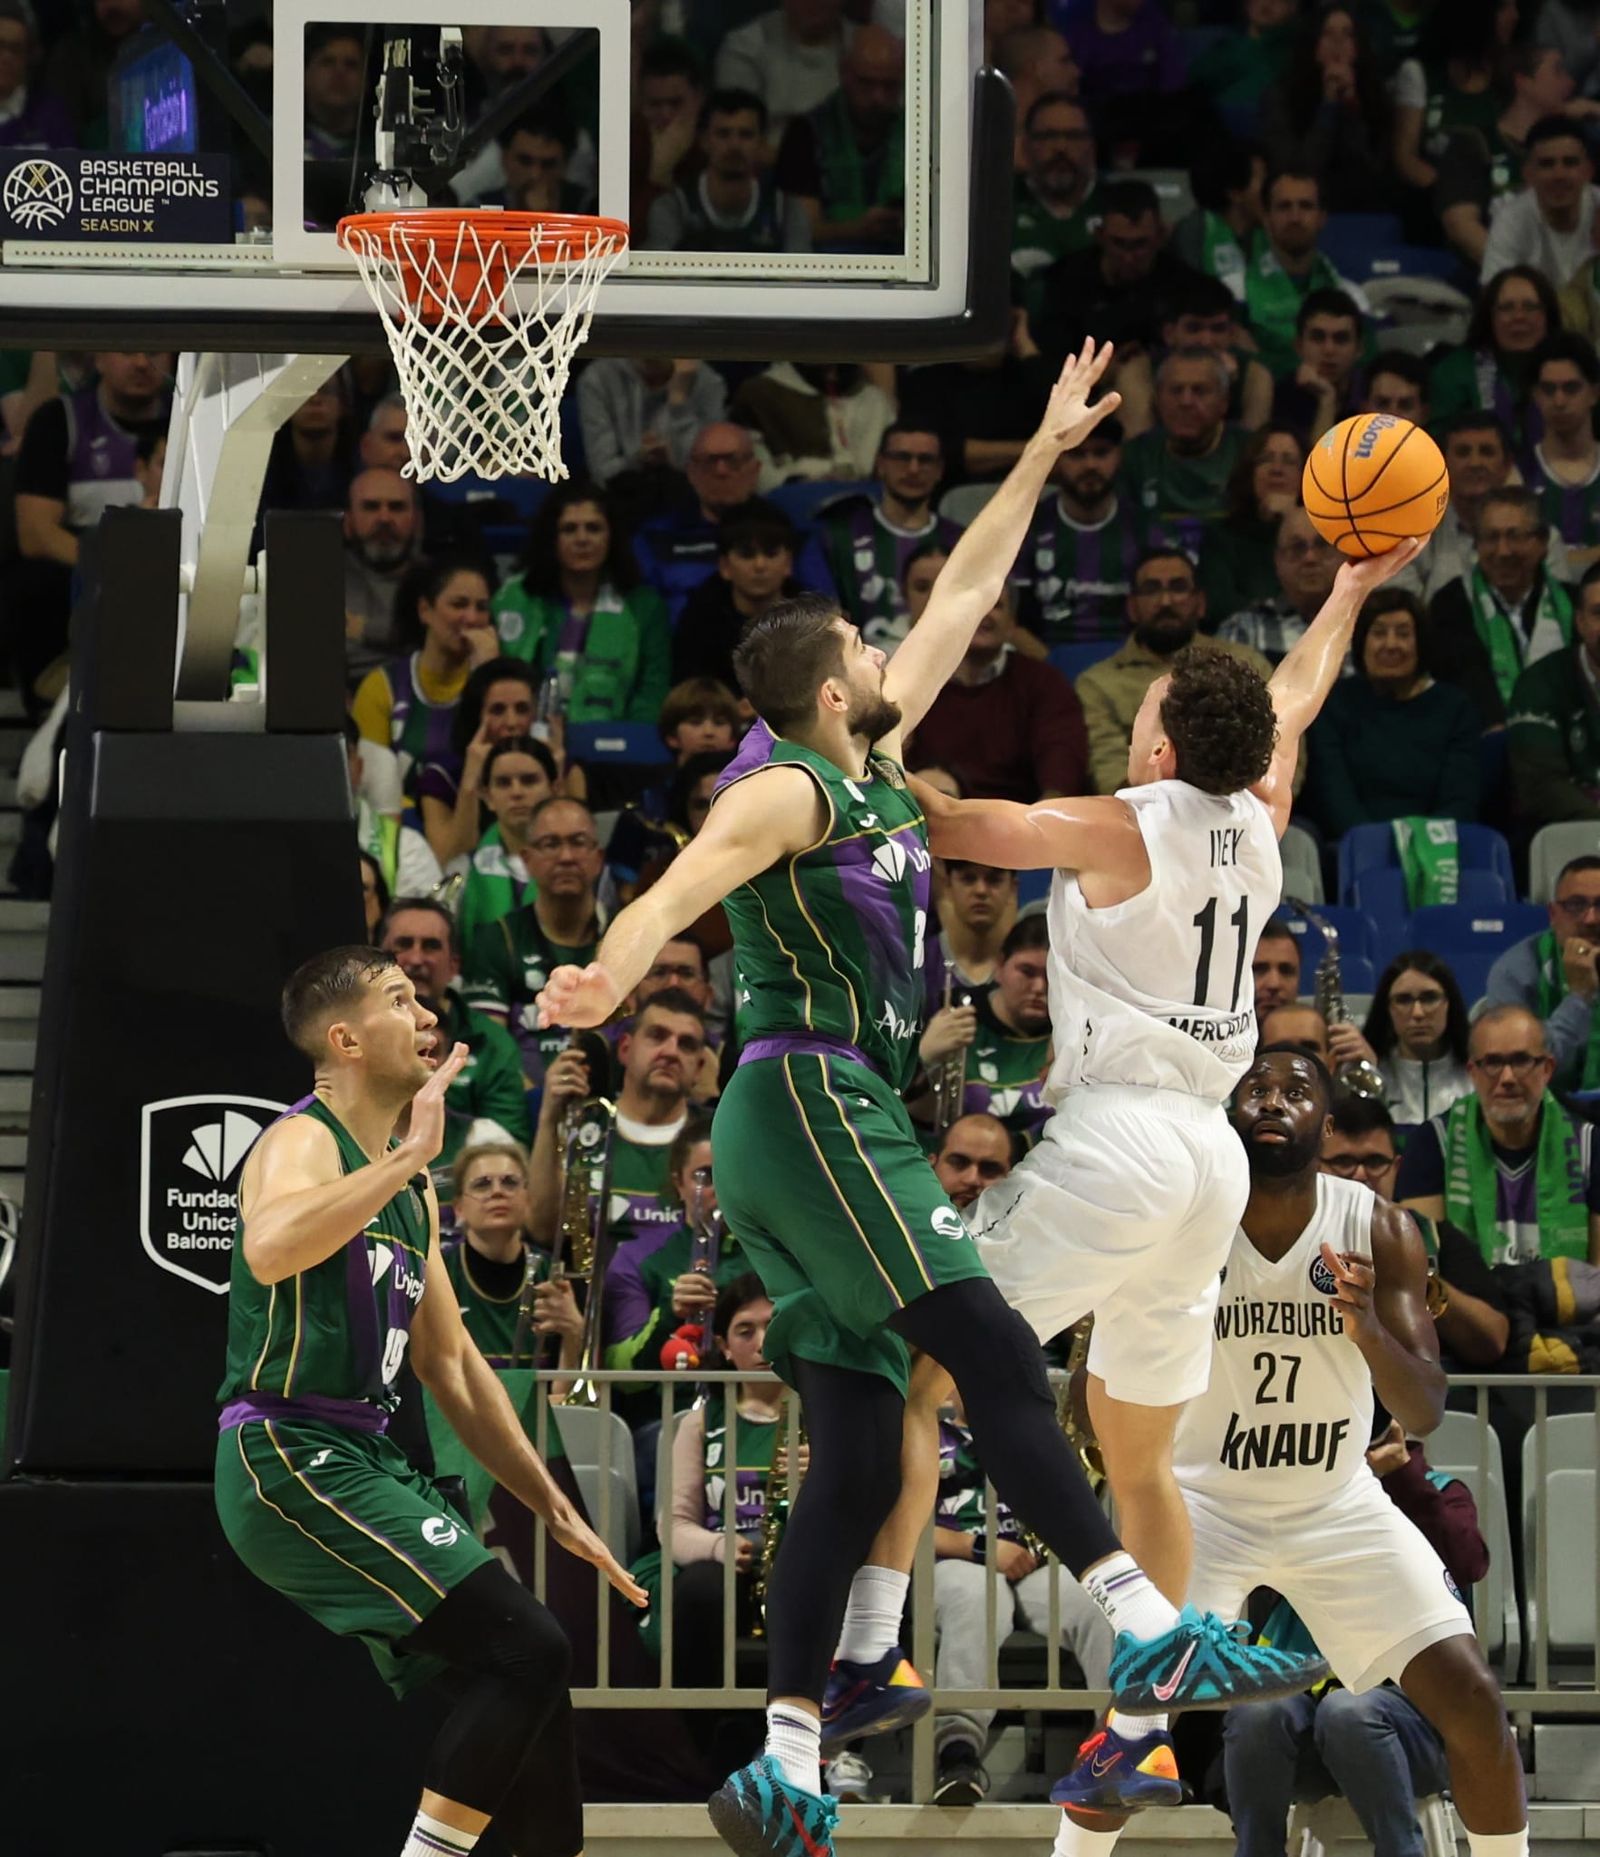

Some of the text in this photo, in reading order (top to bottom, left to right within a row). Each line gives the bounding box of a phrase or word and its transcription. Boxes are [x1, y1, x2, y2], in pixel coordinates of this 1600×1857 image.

[80, 160, 203, 177] BASKETBALL
[80, 178, 219, 197] CHAMPIONS
[80, 198, 155, 213] LEAGUE
[80, 218, 154, 232] SEASON X
[1193, 895, 1248, 1013] 11
[166, 1188, 237, 1208] Fundac
[183, 1212, 237, 1231] Unica
[633, 1206, 683, 1223] Unic
[167, 1233, 234, 1250] Balonc
[1214, 1296, 1344, 1341] WÜRZBURG
[1253, 1352, 1301, 1405] 27
[1220, 1411, 1350, 1472] KNAUF
